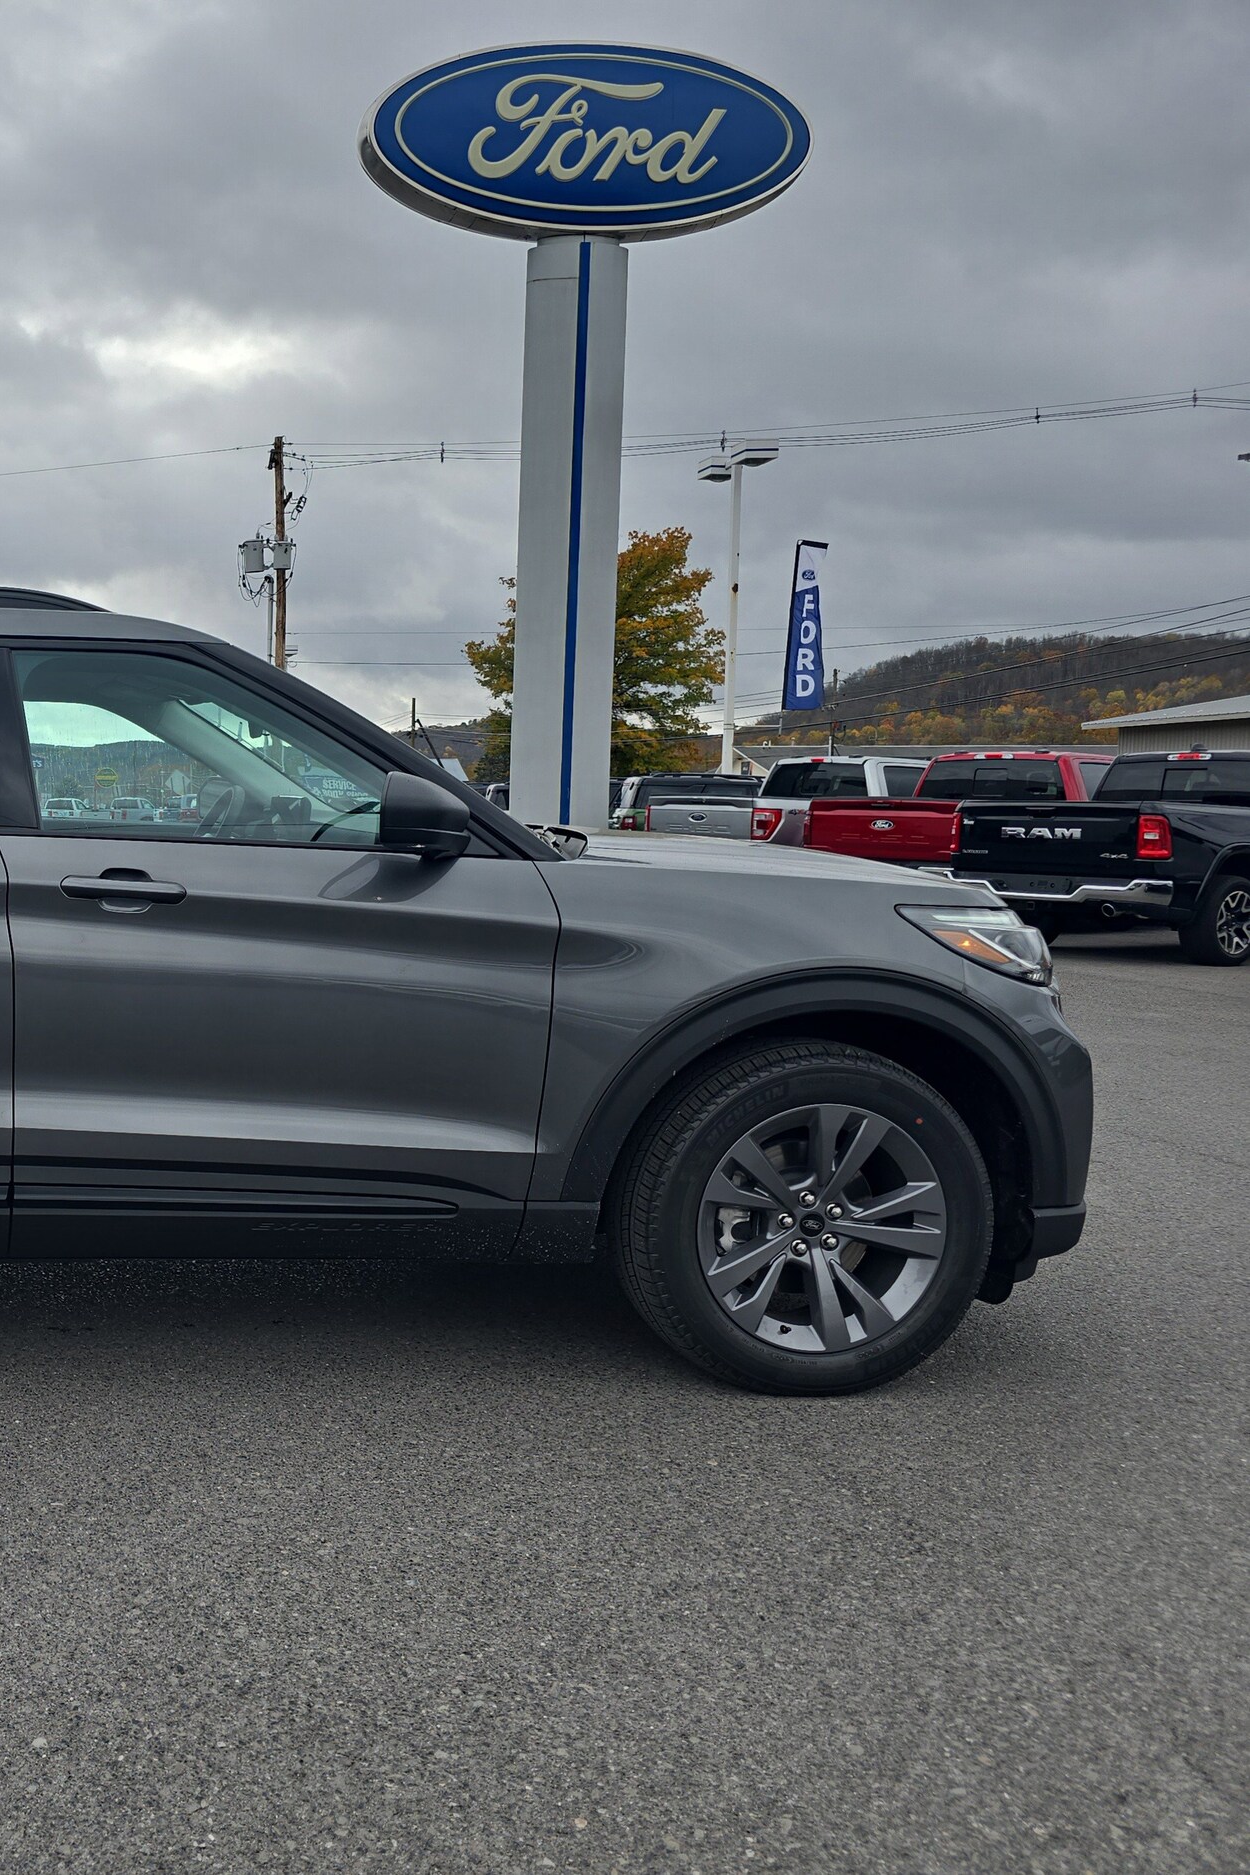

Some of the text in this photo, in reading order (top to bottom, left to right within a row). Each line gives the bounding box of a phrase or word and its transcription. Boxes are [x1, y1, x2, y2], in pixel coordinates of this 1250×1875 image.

[467, 73, 727, 184] Ford
[796, 594, 817, 697] FORD
[322, 779, 357, 791] SERVICE
[1001, 826, 1082, 839] RAM
[705, 1084, 785, 1148] MICHELIN
[251, 1222, 441, 1232] EXPLORER
